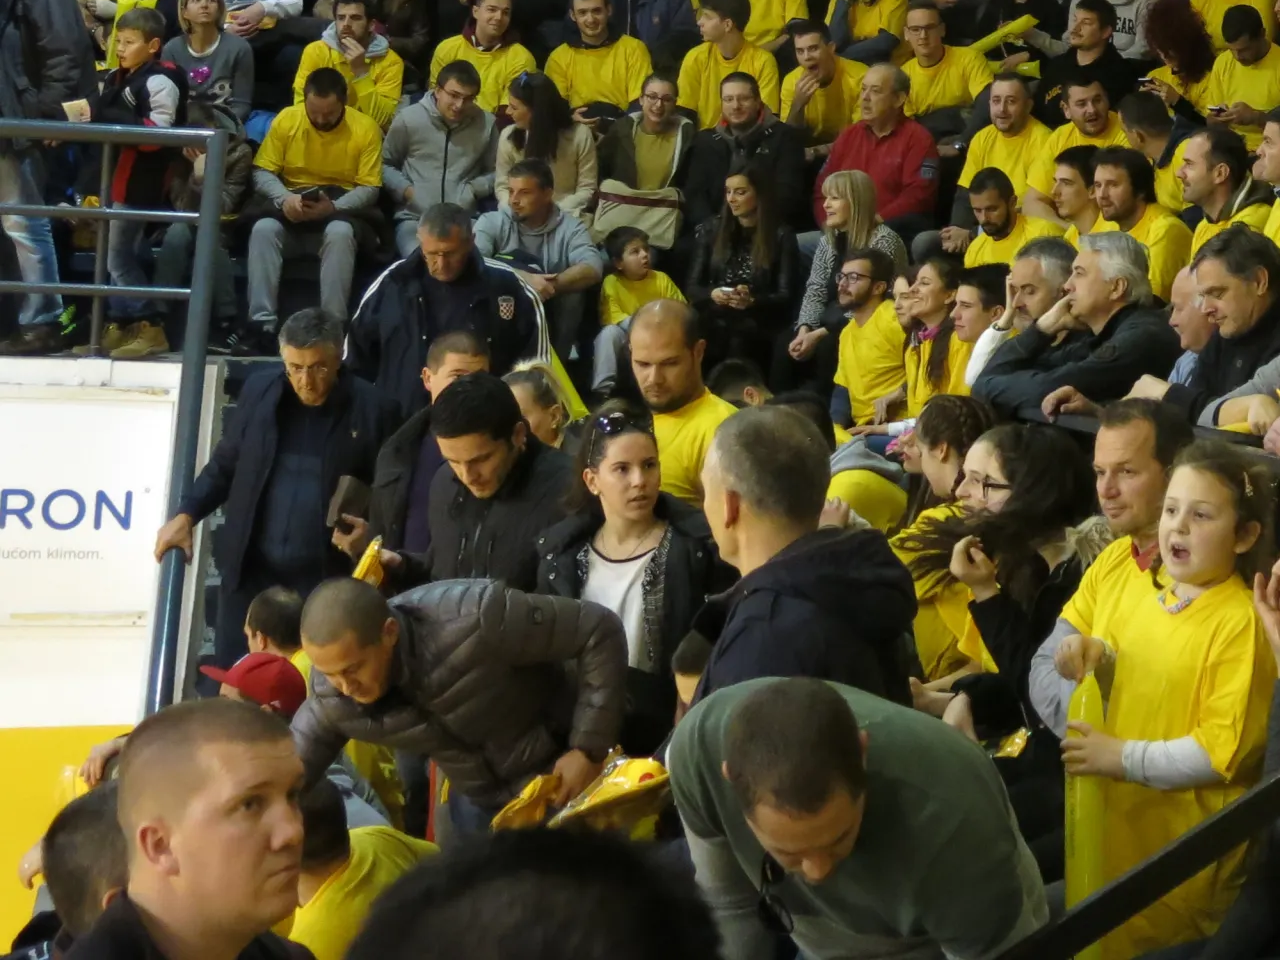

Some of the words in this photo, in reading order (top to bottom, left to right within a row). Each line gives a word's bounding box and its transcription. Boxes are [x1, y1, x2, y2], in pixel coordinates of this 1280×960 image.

[0, 488, 133, 531] RON
[0, 546, 42, 560] ućom
[47, 546, 104, 560] klimom.
